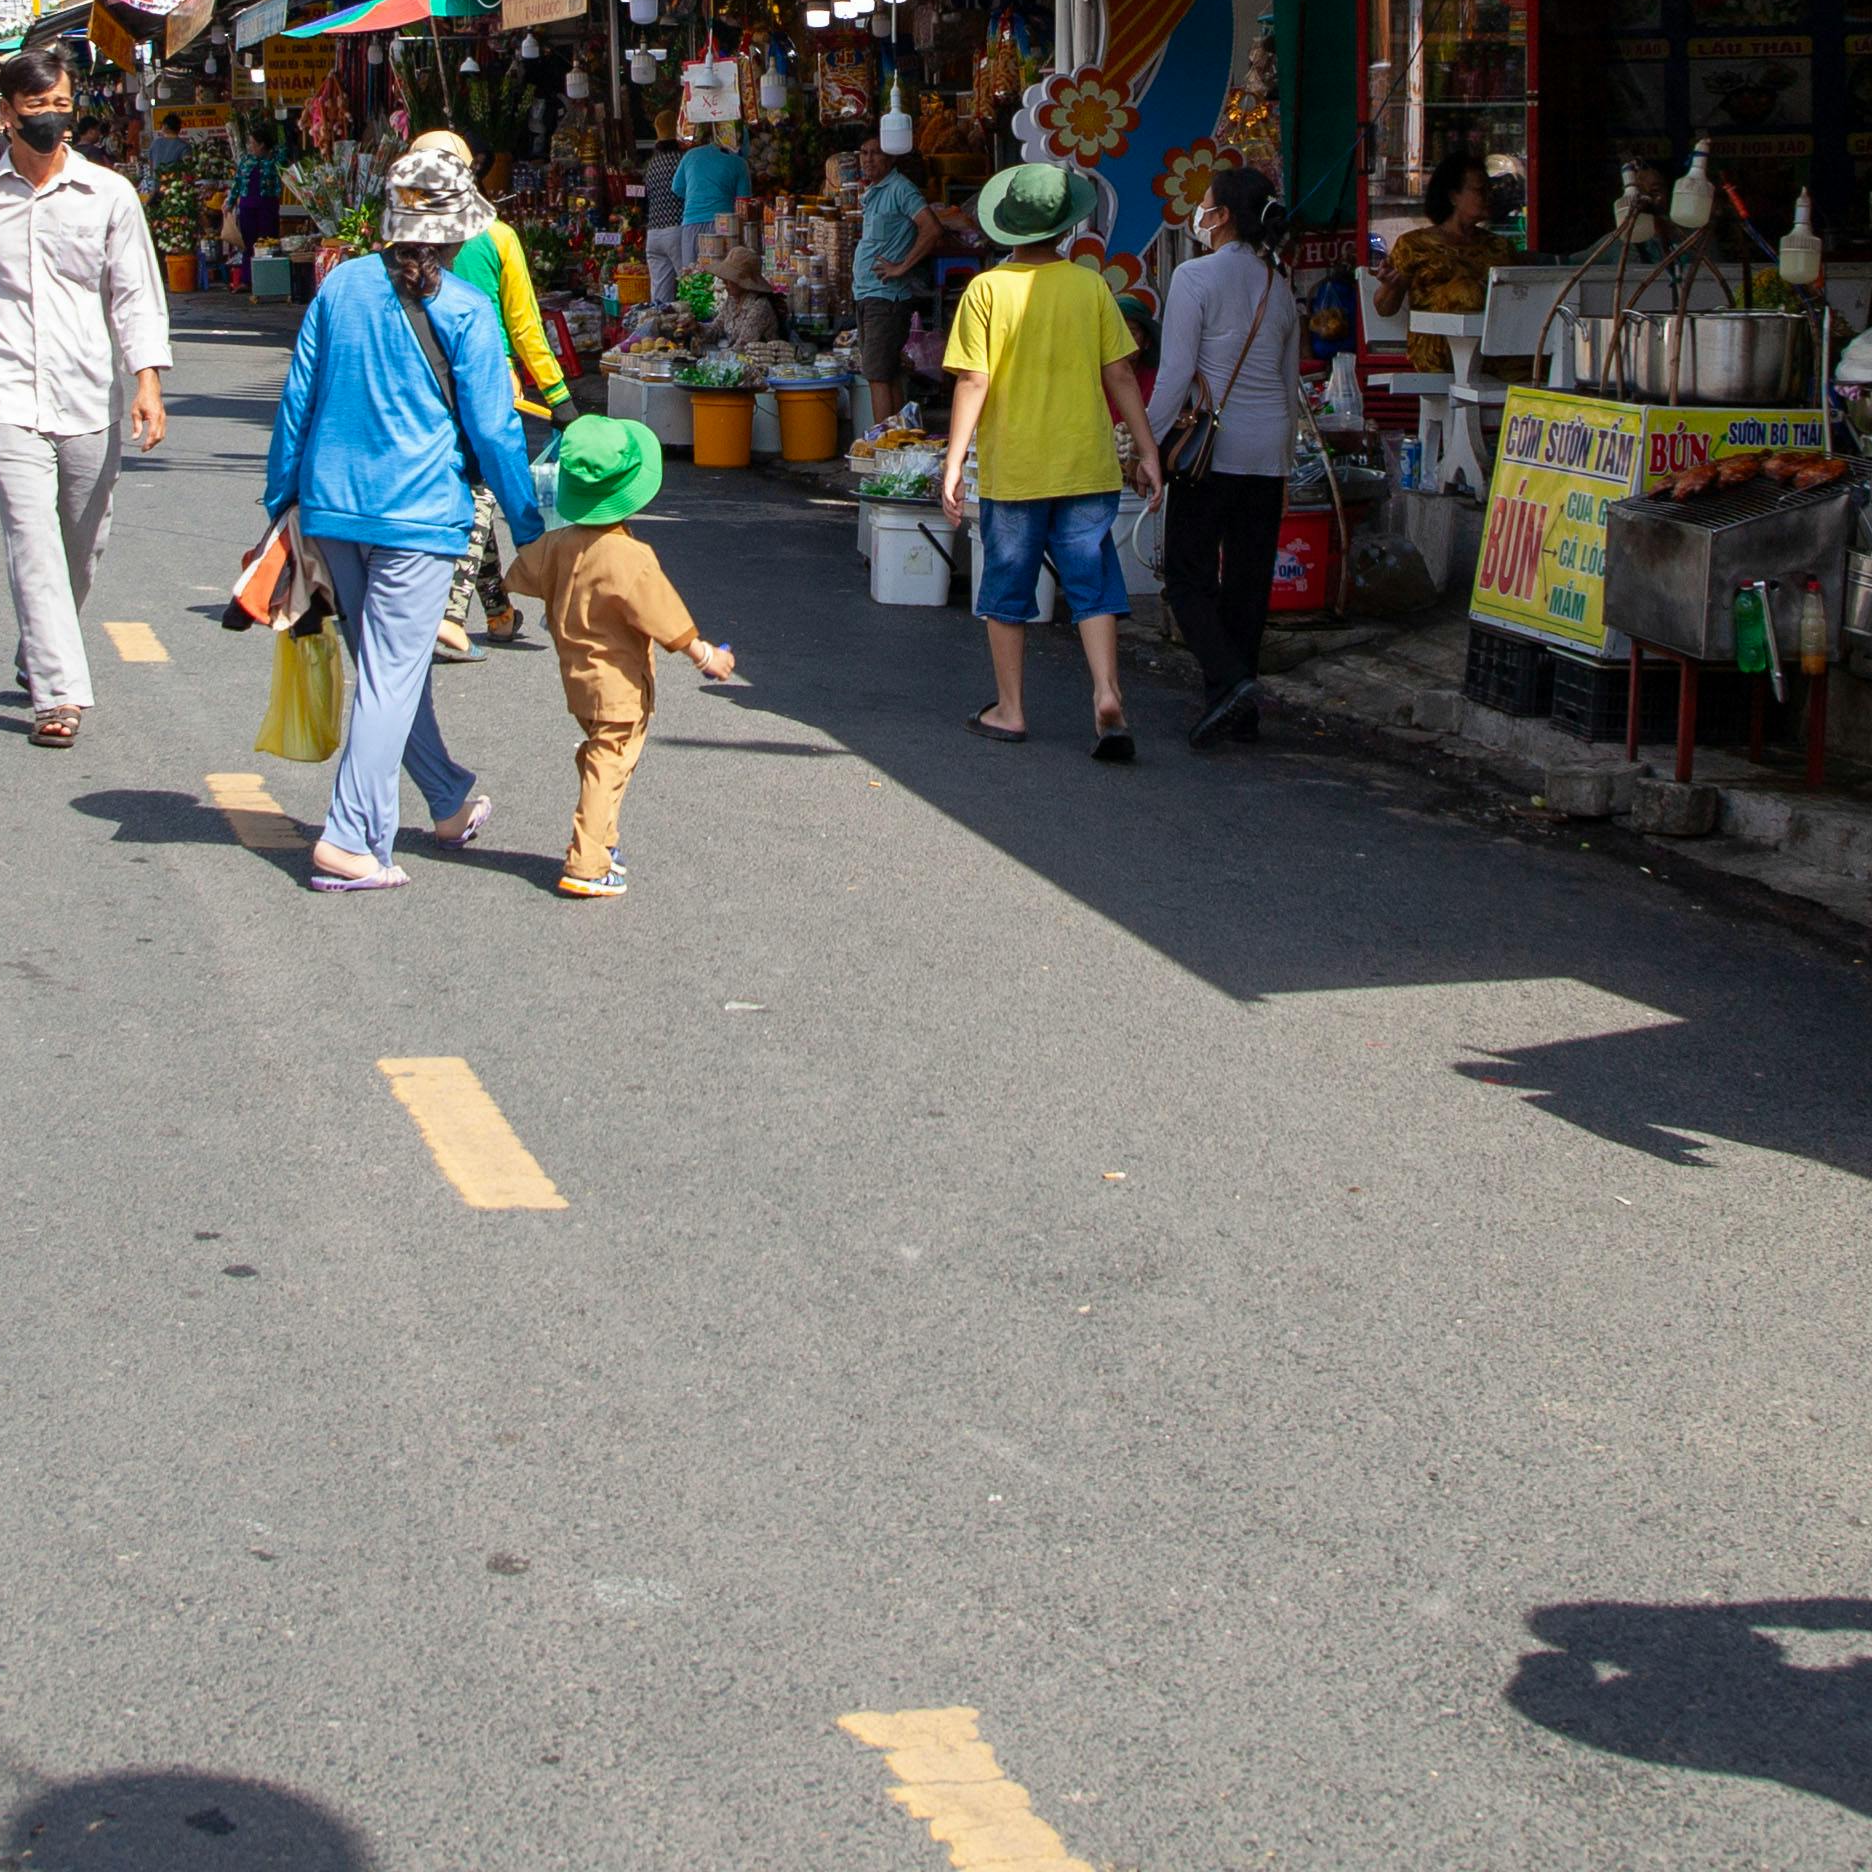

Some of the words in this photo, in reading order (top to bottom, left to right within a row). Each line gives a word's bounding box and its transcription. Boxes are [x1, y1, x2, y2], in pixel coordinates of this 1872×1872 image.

[1504, 411, 1543, 460] CƠM
[1544, 415, 1592, 468] SƯỜN
[1594, 417, 1636, 477] TẤM
[1649, 421, 1711, 476] BÚN
[1728, 416, 1767, 447] SƯỜN
[1565, 491, 1595, 526] CUA
[1479, 479, 1549, 601] BÚN
[1558, 536, 1579, 570] CÁ
[1579, 538, 1606, 577] LÓC
[1279, 565, 1305, 578] OMO
